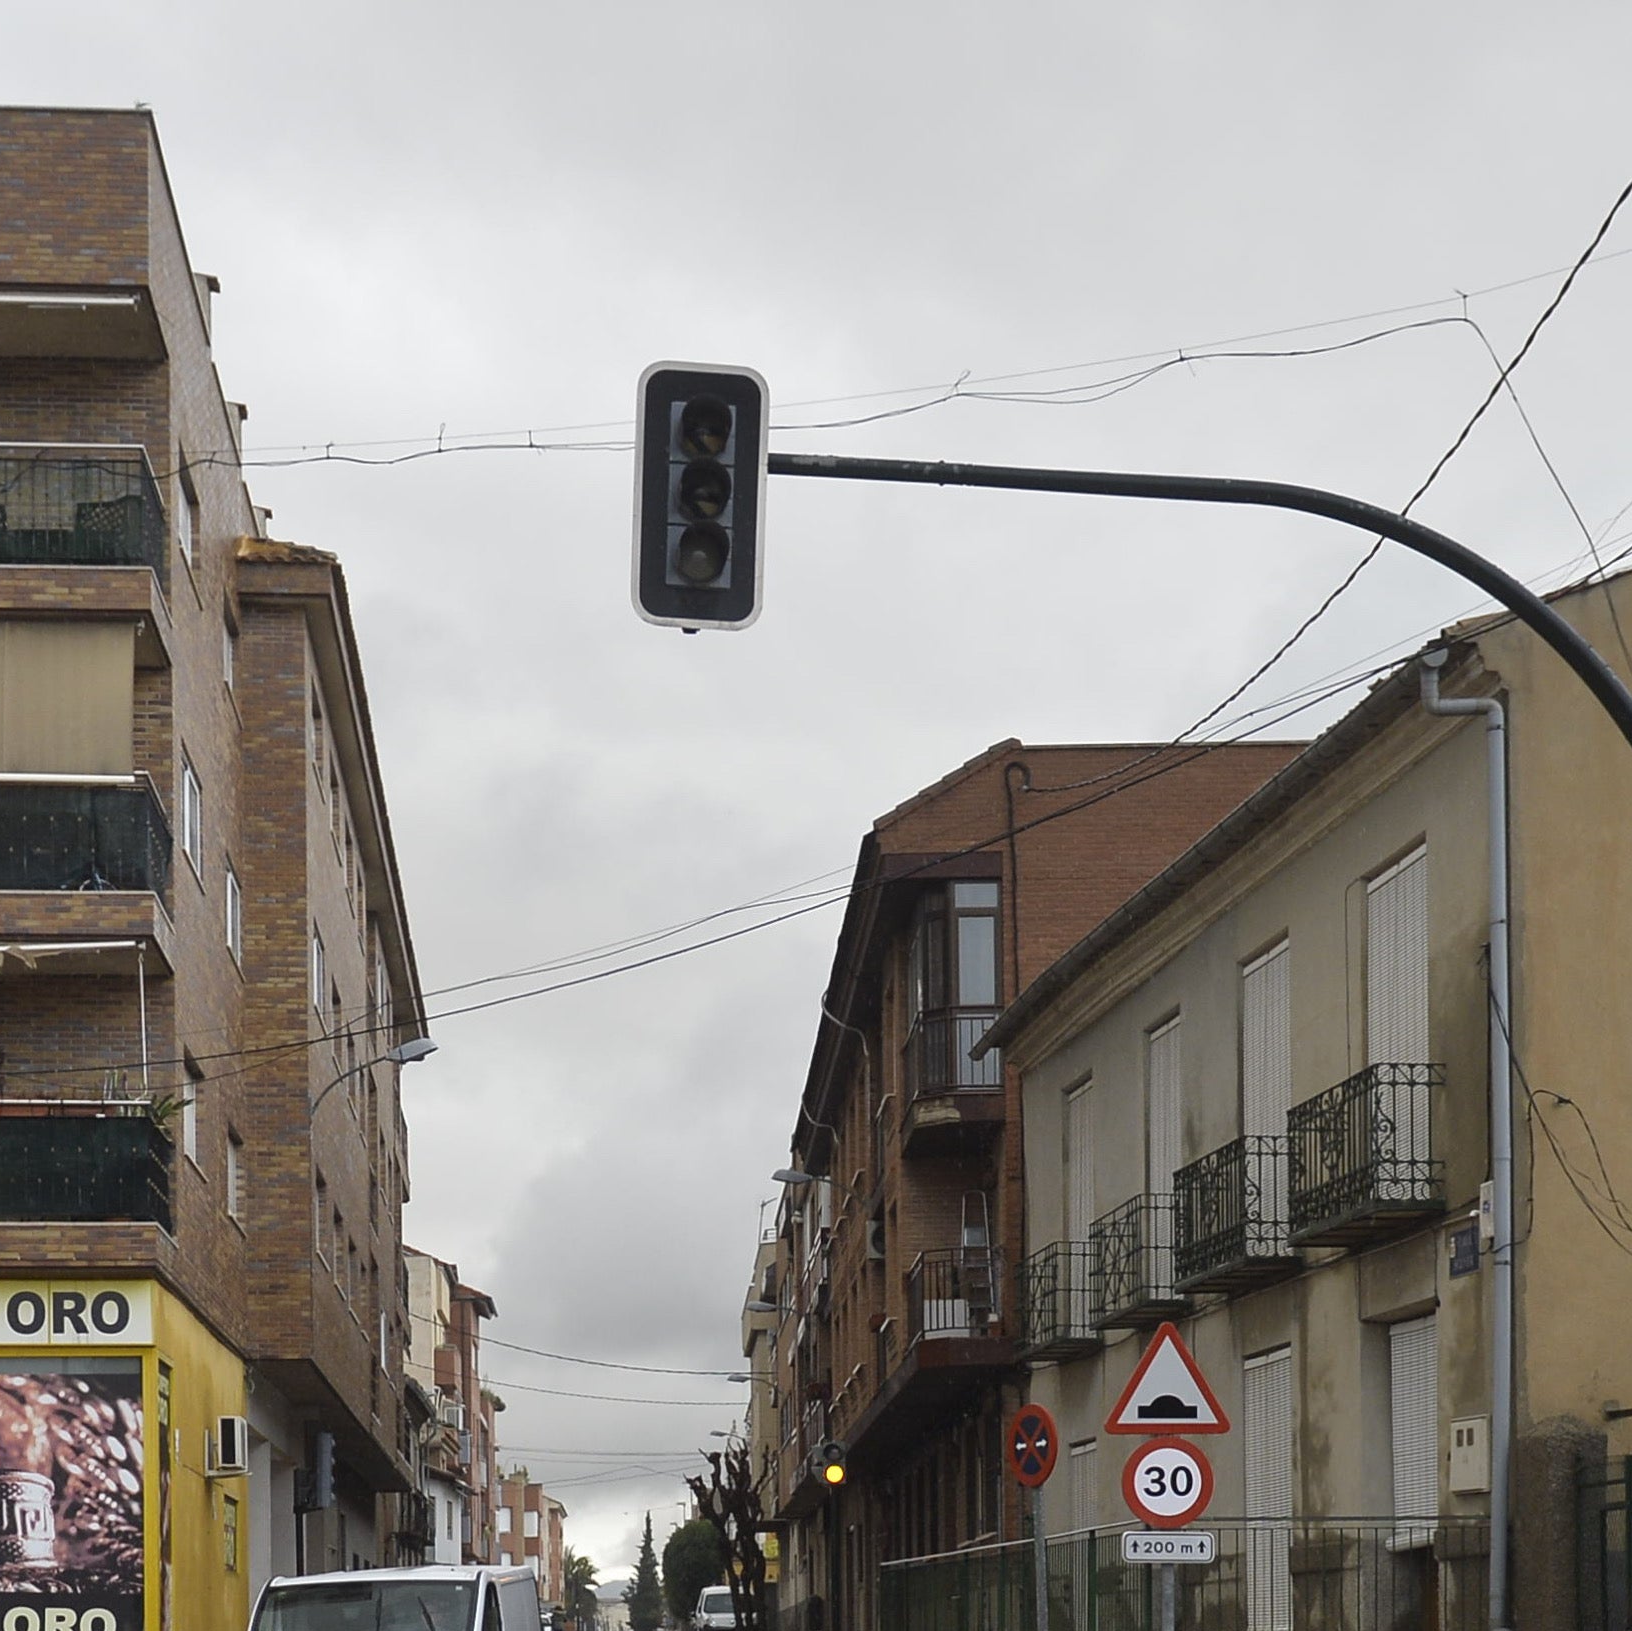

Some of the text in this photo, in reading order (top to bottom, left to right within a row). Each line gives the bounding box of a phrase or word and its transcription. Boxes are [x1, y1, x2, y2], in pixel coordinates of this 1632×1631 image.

[6, 1291, 131, 1336] ORO
[1143, 1466, 1194, 1497] 30
[1143, 1541, 1193, 1554] 200 m
